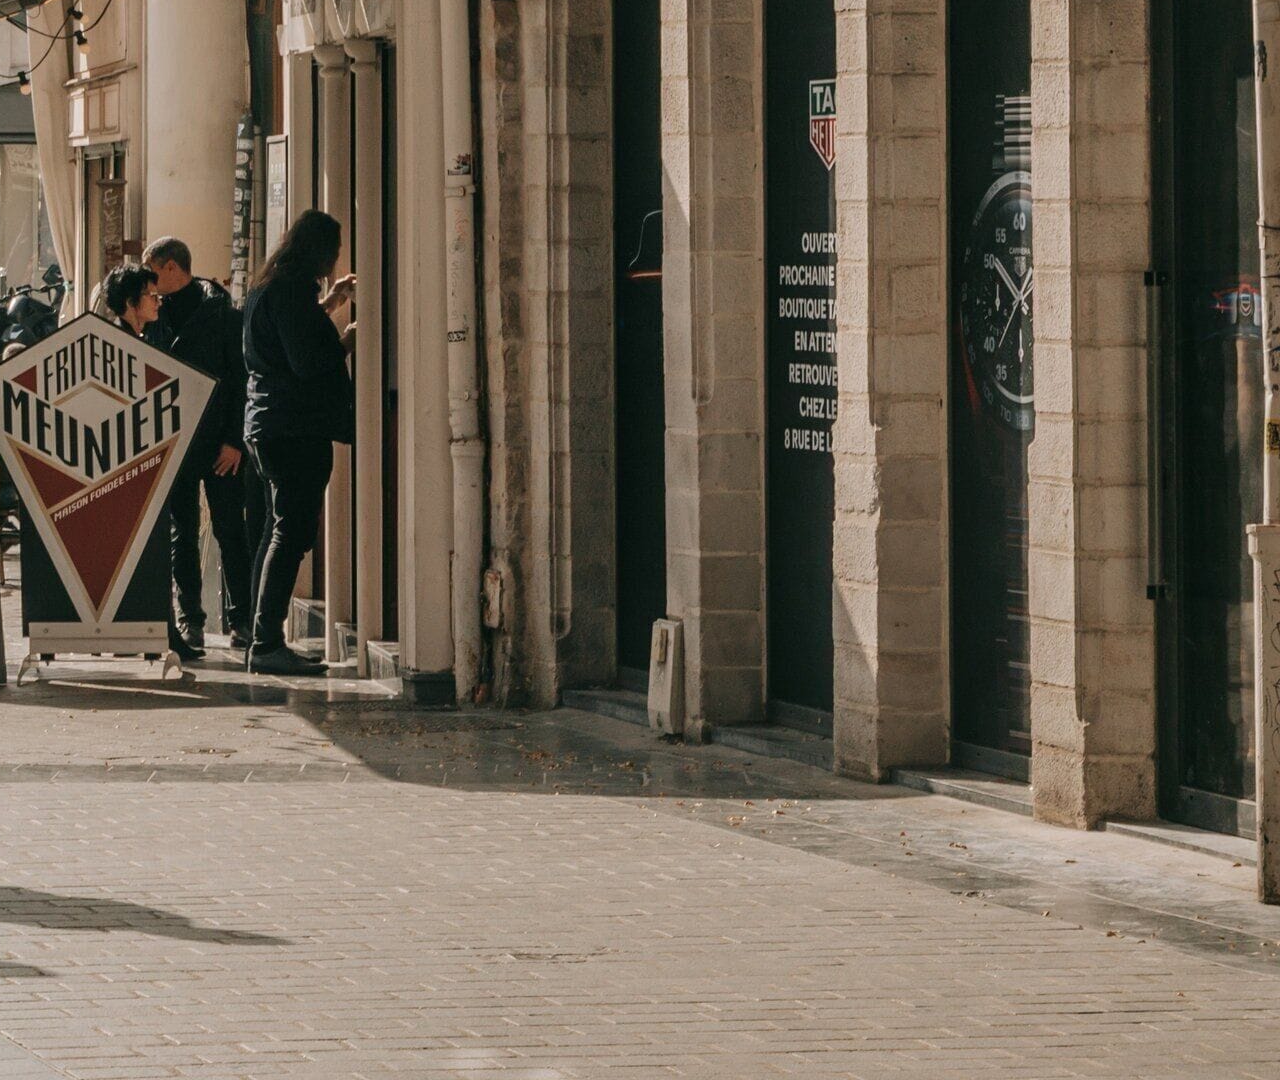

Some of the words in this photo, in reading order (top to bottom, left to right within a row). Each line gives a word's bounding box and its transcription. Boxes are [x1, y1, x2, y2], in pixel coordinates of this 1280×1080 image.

[1013, 211, 1026, 231] 60
[995, 227, 1007, 243] 55
[983, 253, 995, 269] 50
[779, 265, 835, 287] PROCHAINE
[779, 297, 827, 320] BOUTIQUE
[794, 330, 807, 351] EN
[983, 336, 995, 353] 40
[43, 332, 139, 401] FRITERIE
[788, 363, 838, 387] RETROUVE
[995, 364, 1008, 381] 35
[799, 396, 825, 418] CHEZ
[2, 376, 181, 480] MEUNIER
[784, 427, 791, 449] 8
[791, 429, 811, 450] RUE
[811, 430, 825, 452] DE
[53, 497, 89, 522] MAISON
[125, 466, 139, 482] EN
[139, 453, 162, 473] 1986
